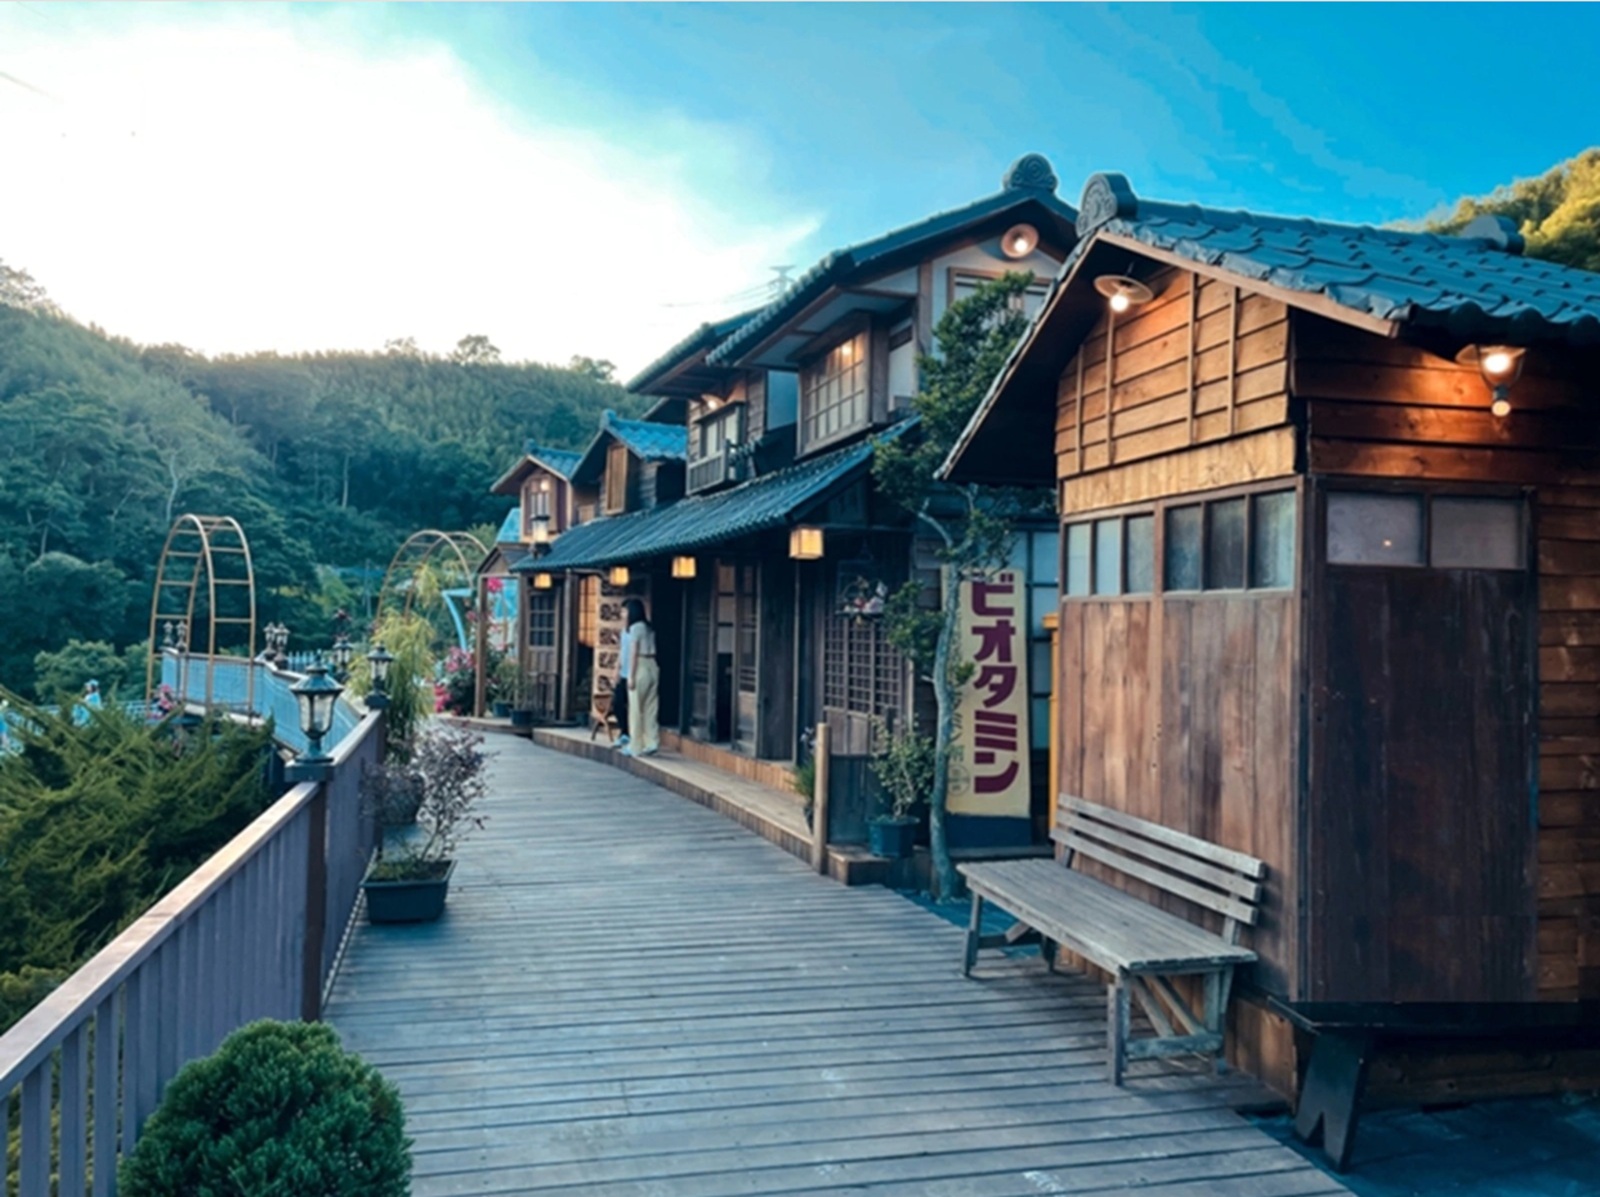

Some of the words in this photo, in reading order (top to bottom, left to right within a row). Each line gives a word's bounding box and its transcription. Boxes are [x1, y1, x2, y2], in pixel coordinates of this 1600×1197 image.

[971, 571, 1020, 794] ビオタミン
